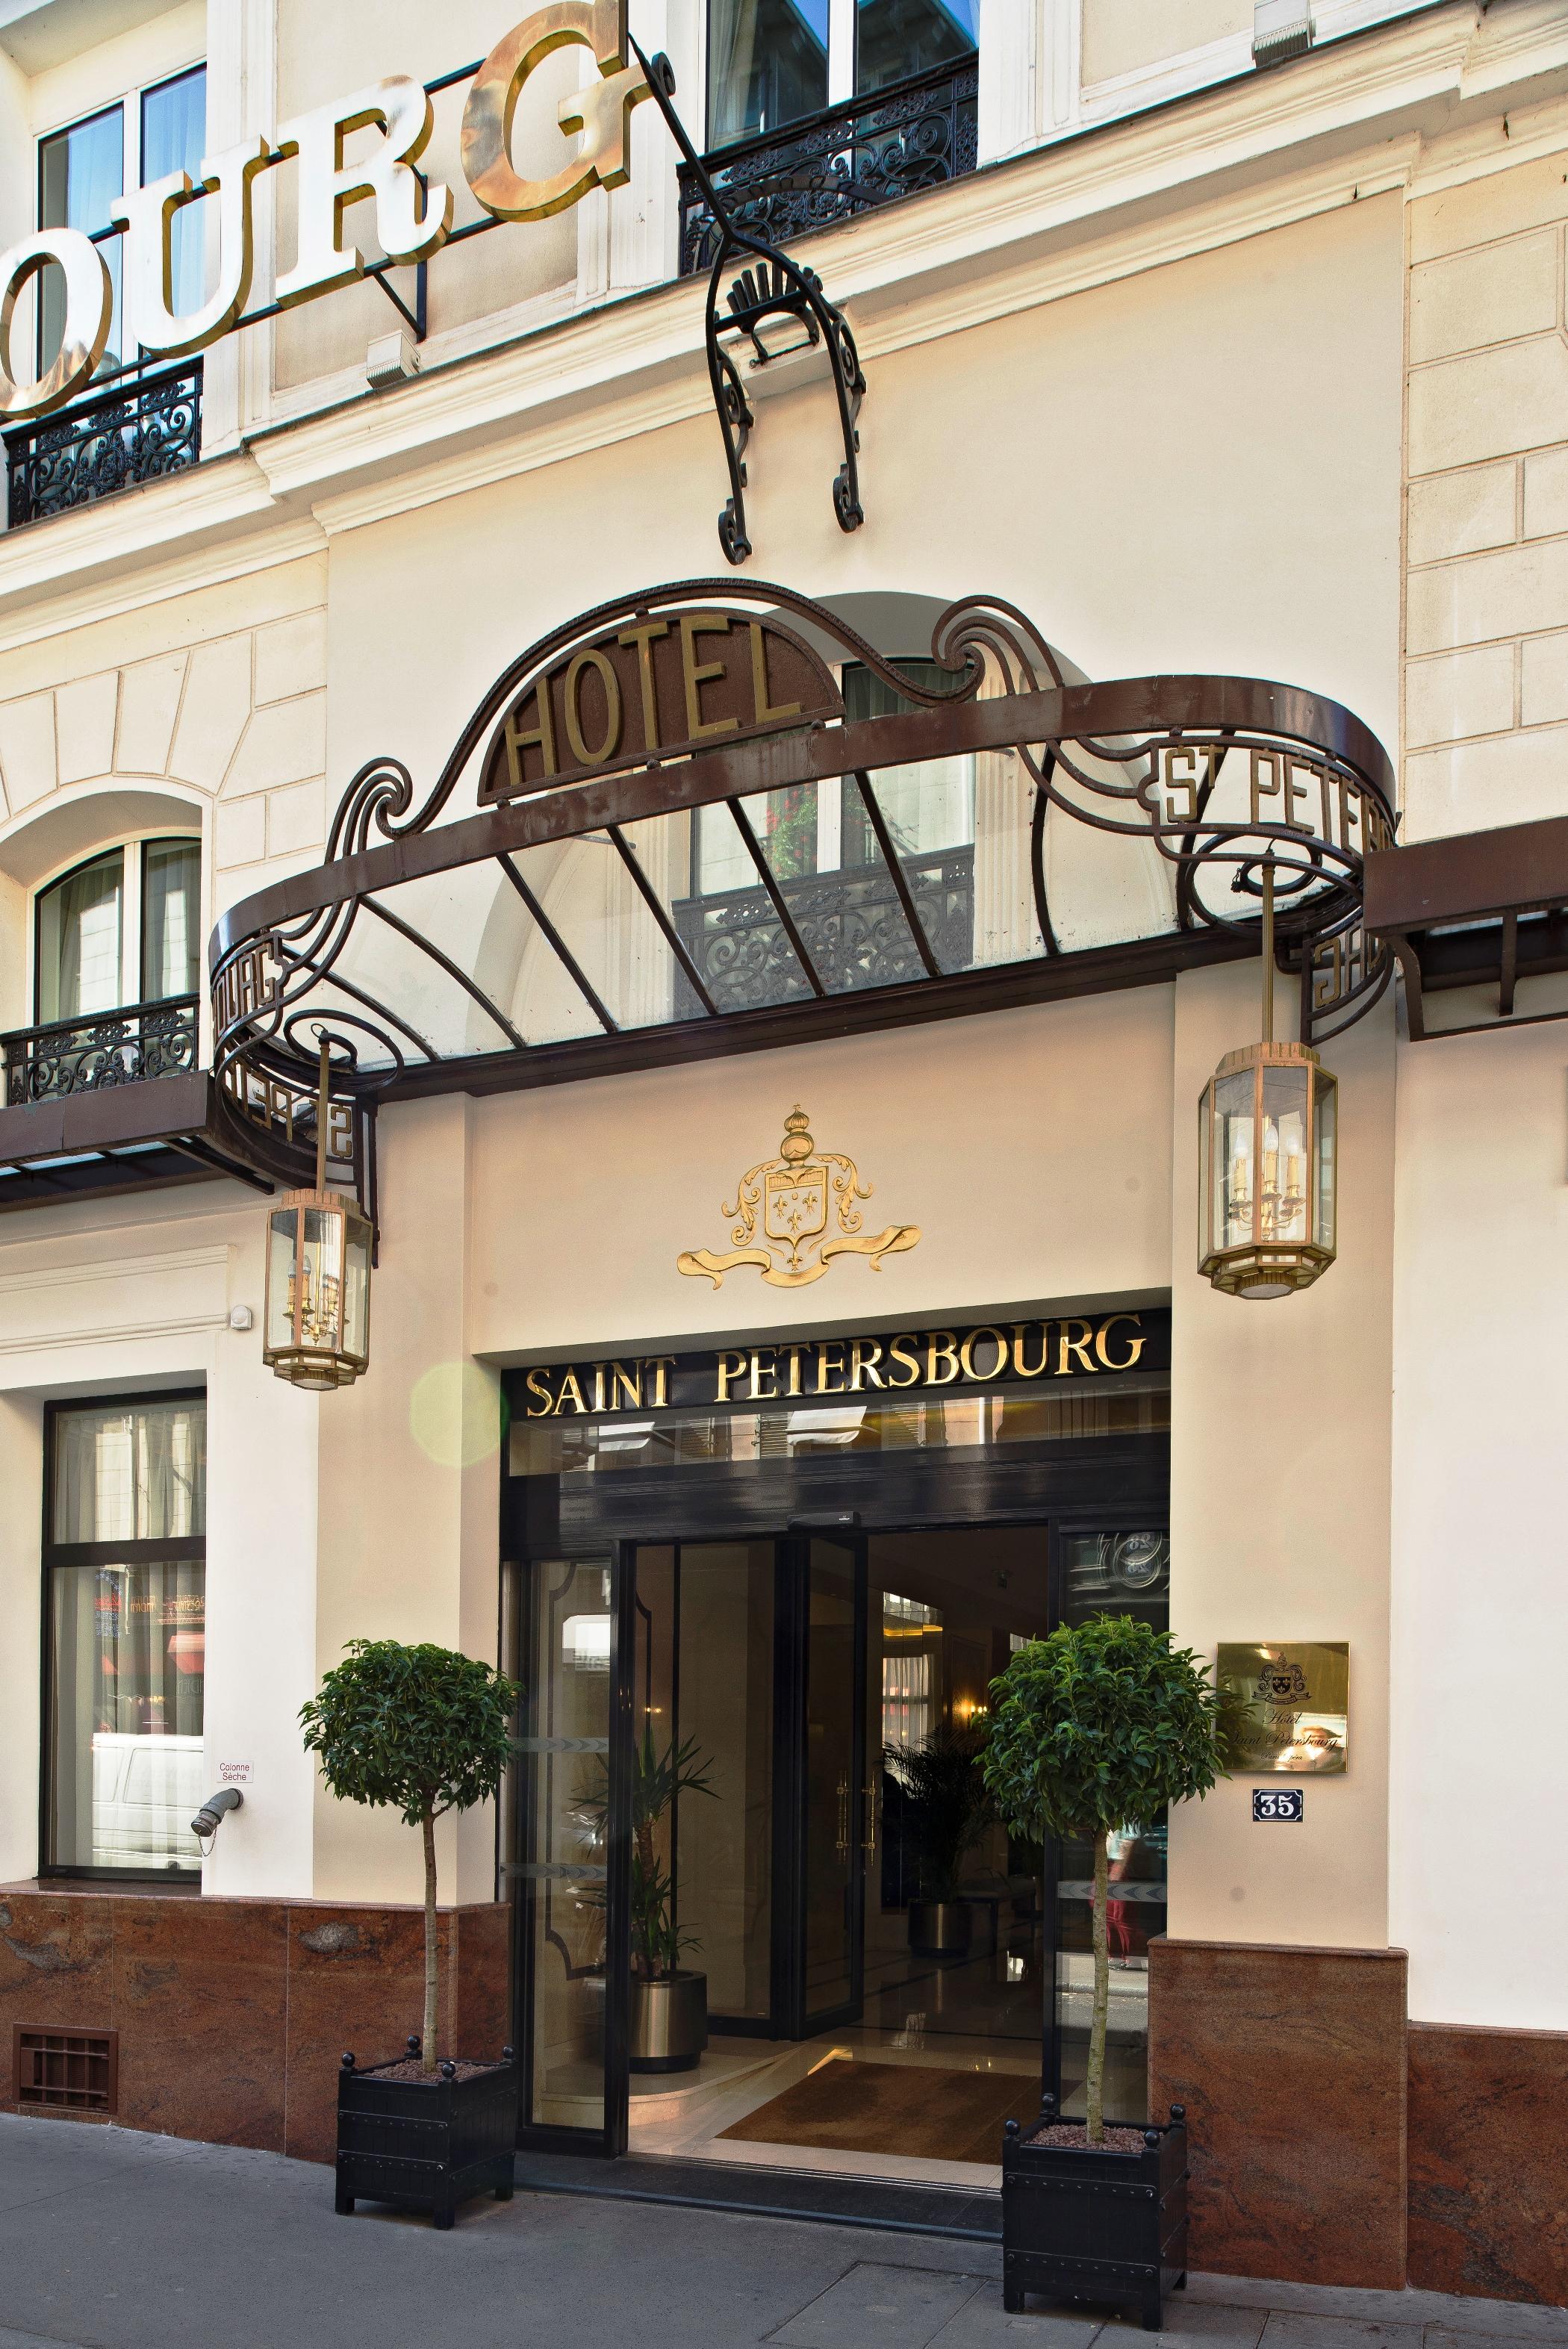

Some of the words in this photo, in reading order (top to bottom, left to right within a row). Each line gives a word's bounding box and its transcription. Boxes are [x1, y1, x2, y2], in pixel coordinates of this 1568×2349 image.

[0, 0, 648, 420] OURG
[504, 615, 802, 787] HOTEL
[1165, 745, 1225, 823] ST
[1250, 748, 1392, 856] PETER
[213, 943, 276, 1039] OURG
[526, 1355, 677, 1417] SAINT
[714, 1313, 1148, 1402] PETERSBOURG
[220, 1762, 249, 1772] Colonne
[1260, 1795, 1294, 1816] 35
[1284, 1752, 1304, 1763] péra
